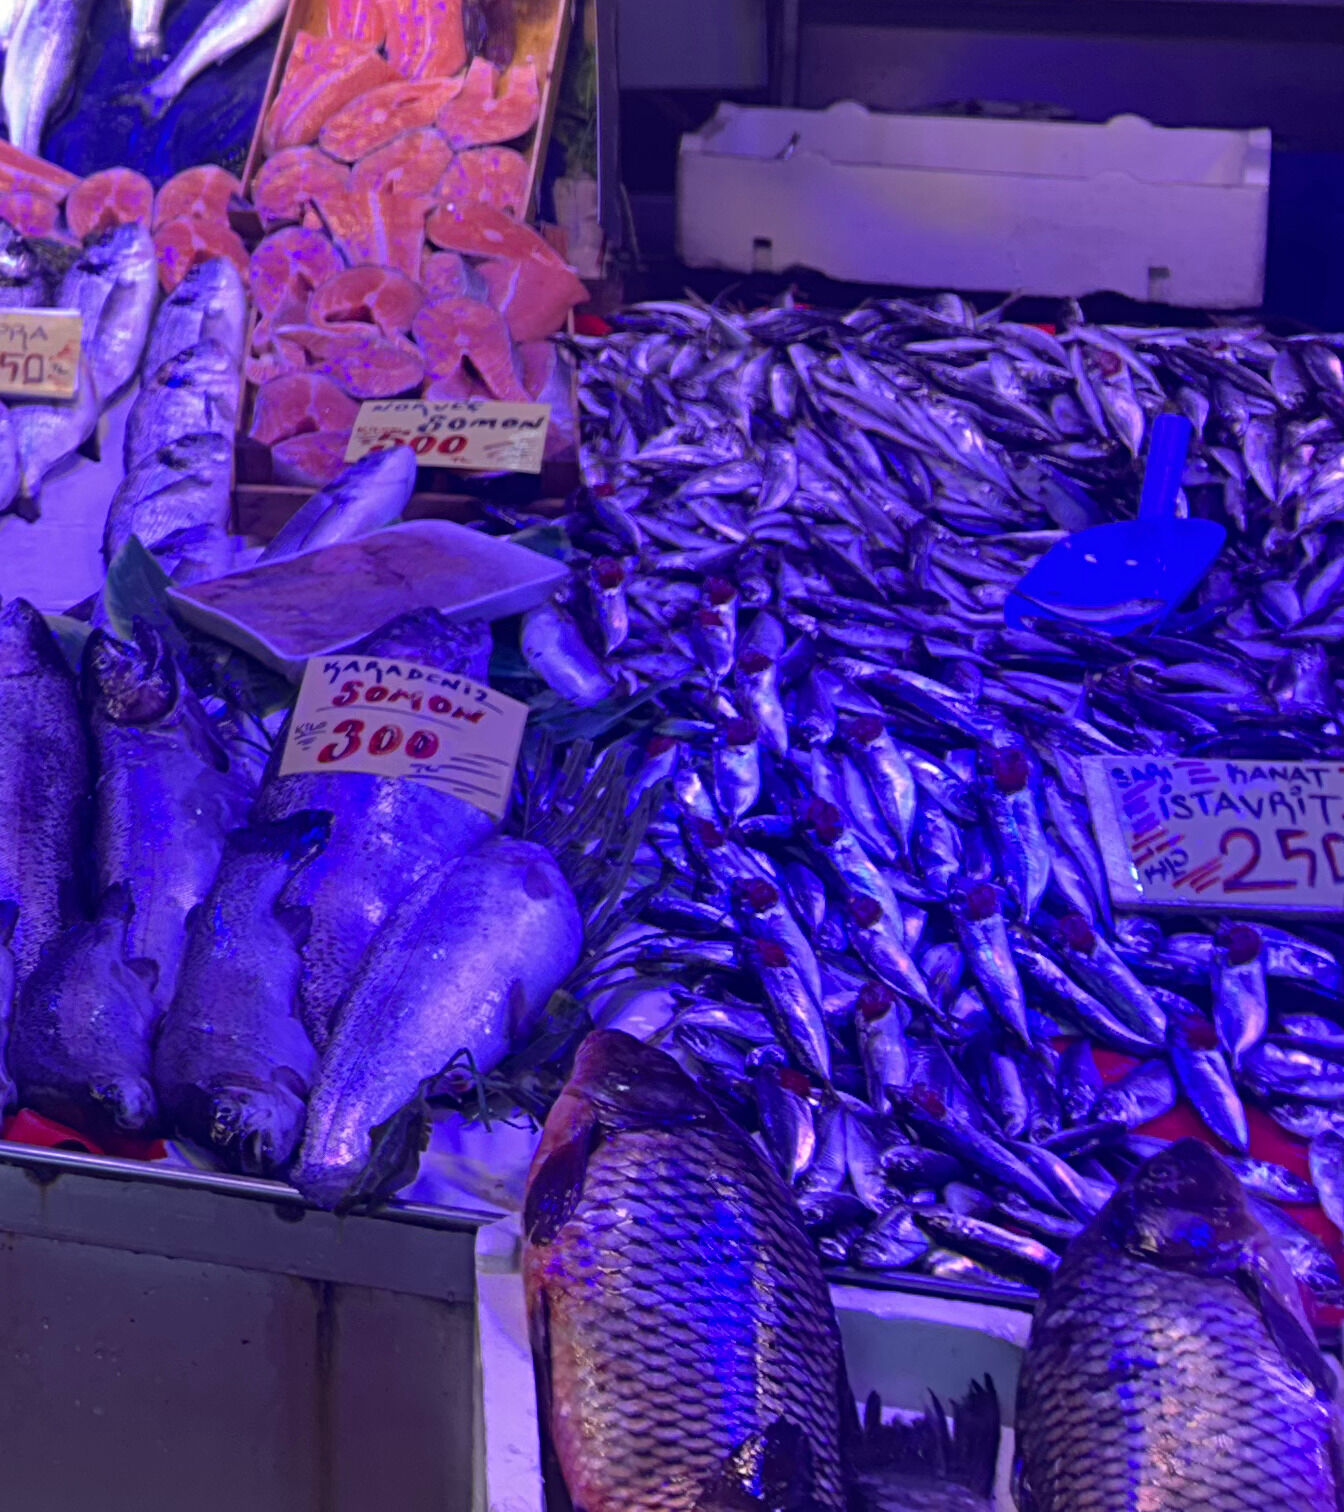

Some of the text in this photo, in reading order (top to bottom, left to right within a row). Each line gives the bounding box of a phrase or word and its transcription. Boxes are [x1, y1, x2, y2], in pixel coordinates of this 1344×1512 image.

[331, 680, 486, 724] SOMON
[317, 719, 440, 764] 300
[1226, 763, 1330, 787] KANAT
